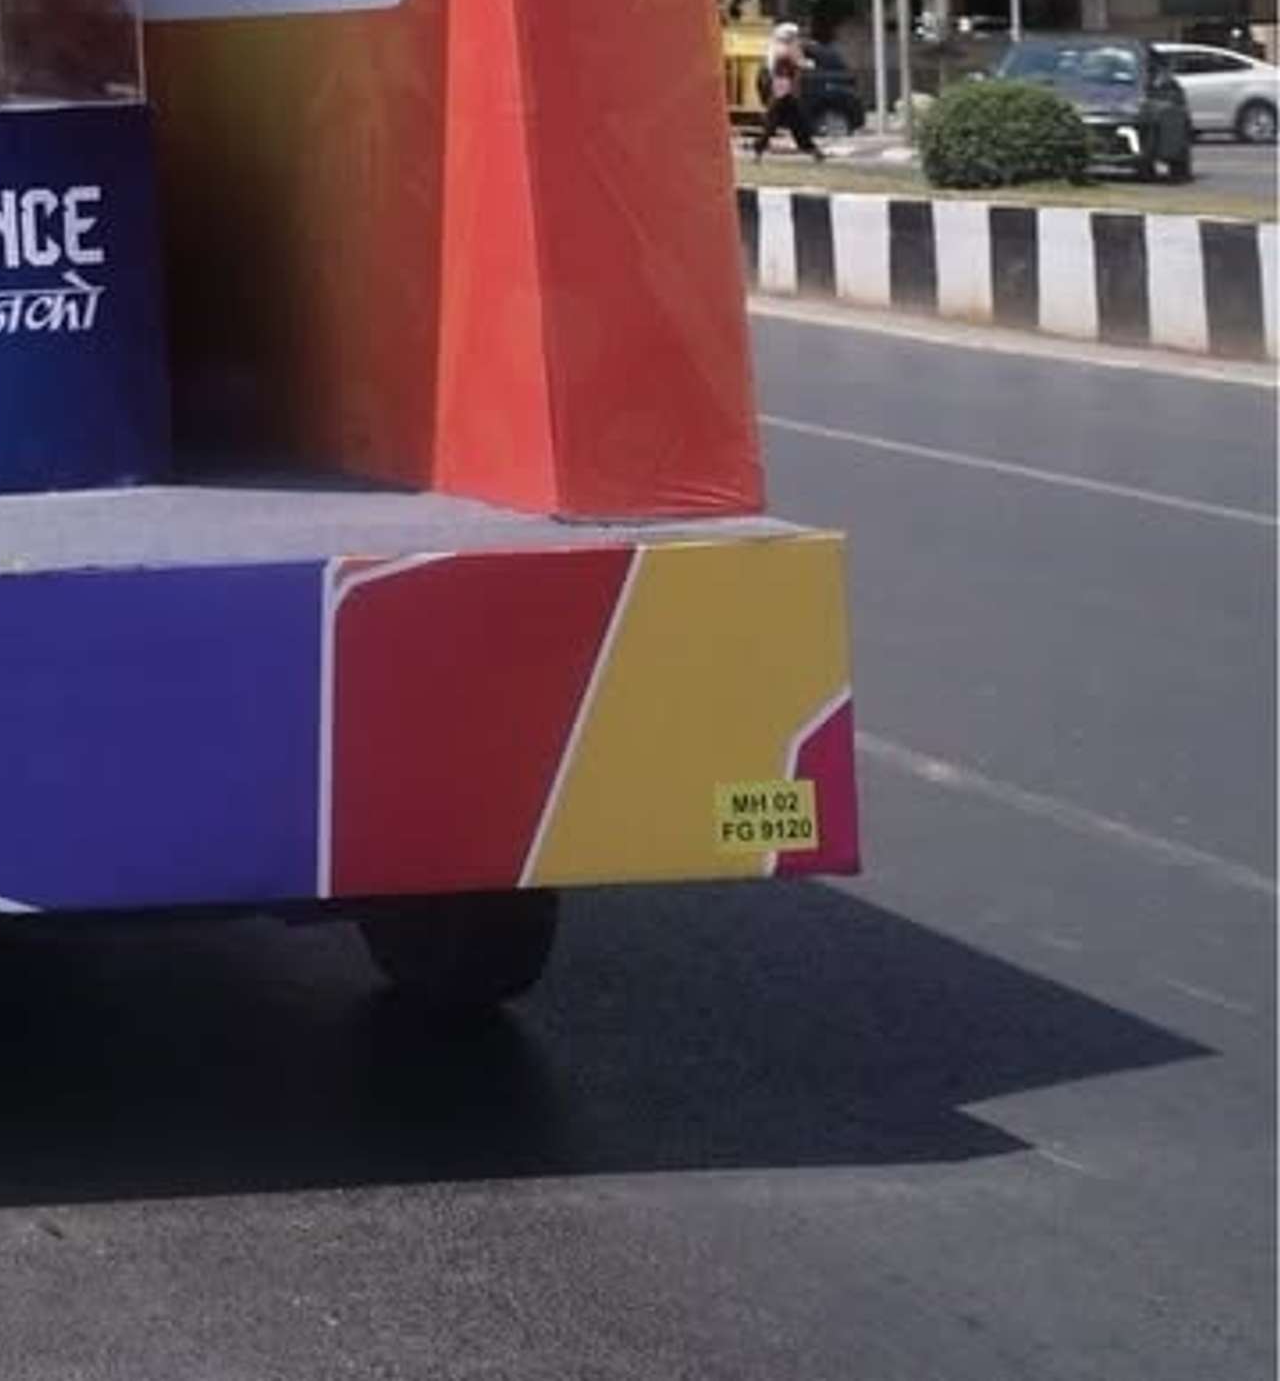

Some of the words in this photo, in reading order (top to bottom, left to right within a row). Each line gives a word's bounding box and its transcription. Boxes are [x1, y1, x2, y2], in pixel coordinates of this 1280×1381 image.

[731, 792, 768, 816] MH
[772, 790, 799, 814] 02
[722, 820, 755, 842] FG
[760, 816, 813, 841] 9120
